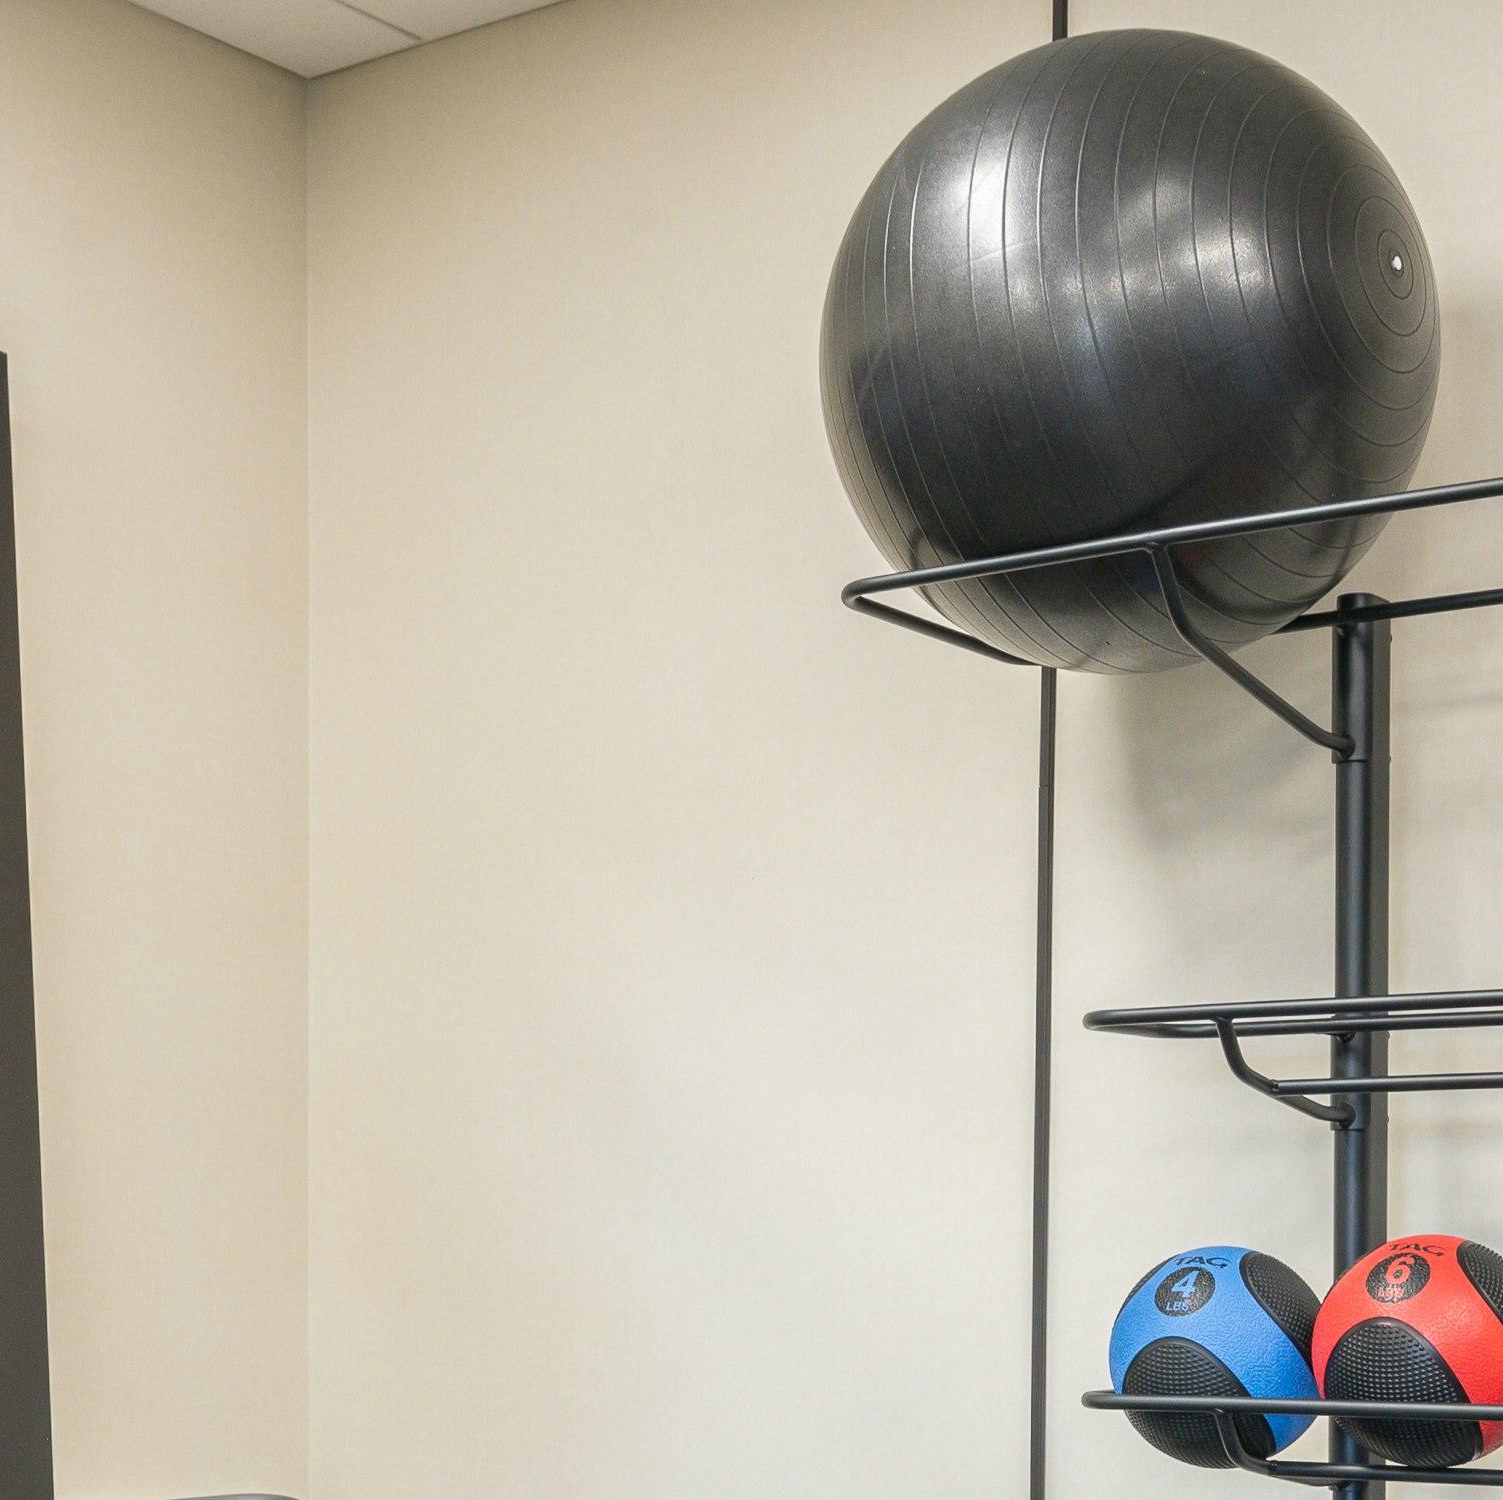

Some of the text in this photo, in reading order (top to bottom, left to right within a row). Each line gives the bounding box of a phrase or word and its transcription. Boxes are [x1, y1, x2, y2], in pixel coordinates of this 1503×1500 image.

[1171, 1270, 1200, 1298] 4
[1385, 1256, 1415, 1285] 6
[1165, 1301, 1191, 1311] LBS
